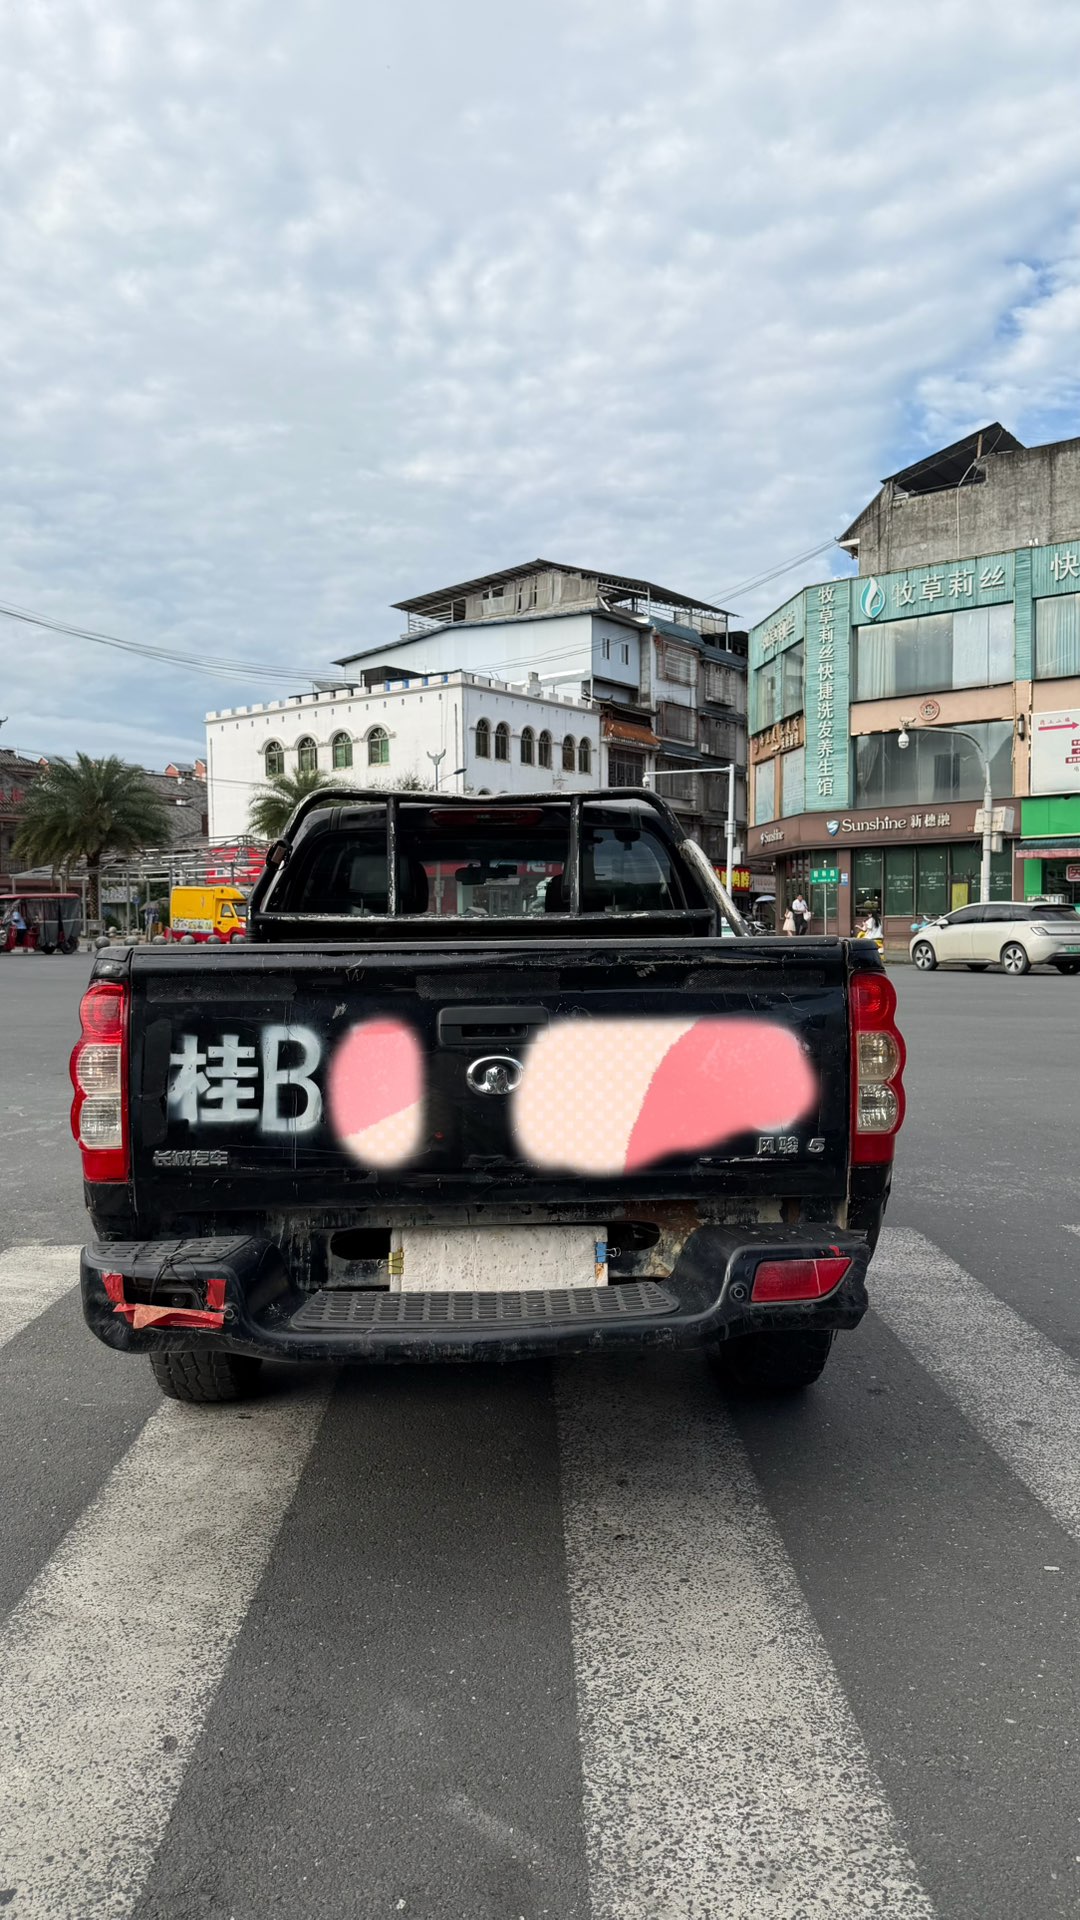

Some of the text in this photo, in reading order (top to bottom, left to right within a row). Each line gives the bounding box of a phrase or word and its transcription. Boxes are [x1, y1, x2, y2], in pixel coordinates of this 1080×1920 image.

[892, 565, 1005, 607] 牧草莉丝
[817, 587, 835, 796] 牧草莉丝快捷洗发养生馆
[842, 816, 906, 833] Sunshine
[168, 1025, 322, 1132] 桂B
[153, 1150, 228, 1166] 长城汽车
[757, 1136, 826, 1154] 风骏 5
